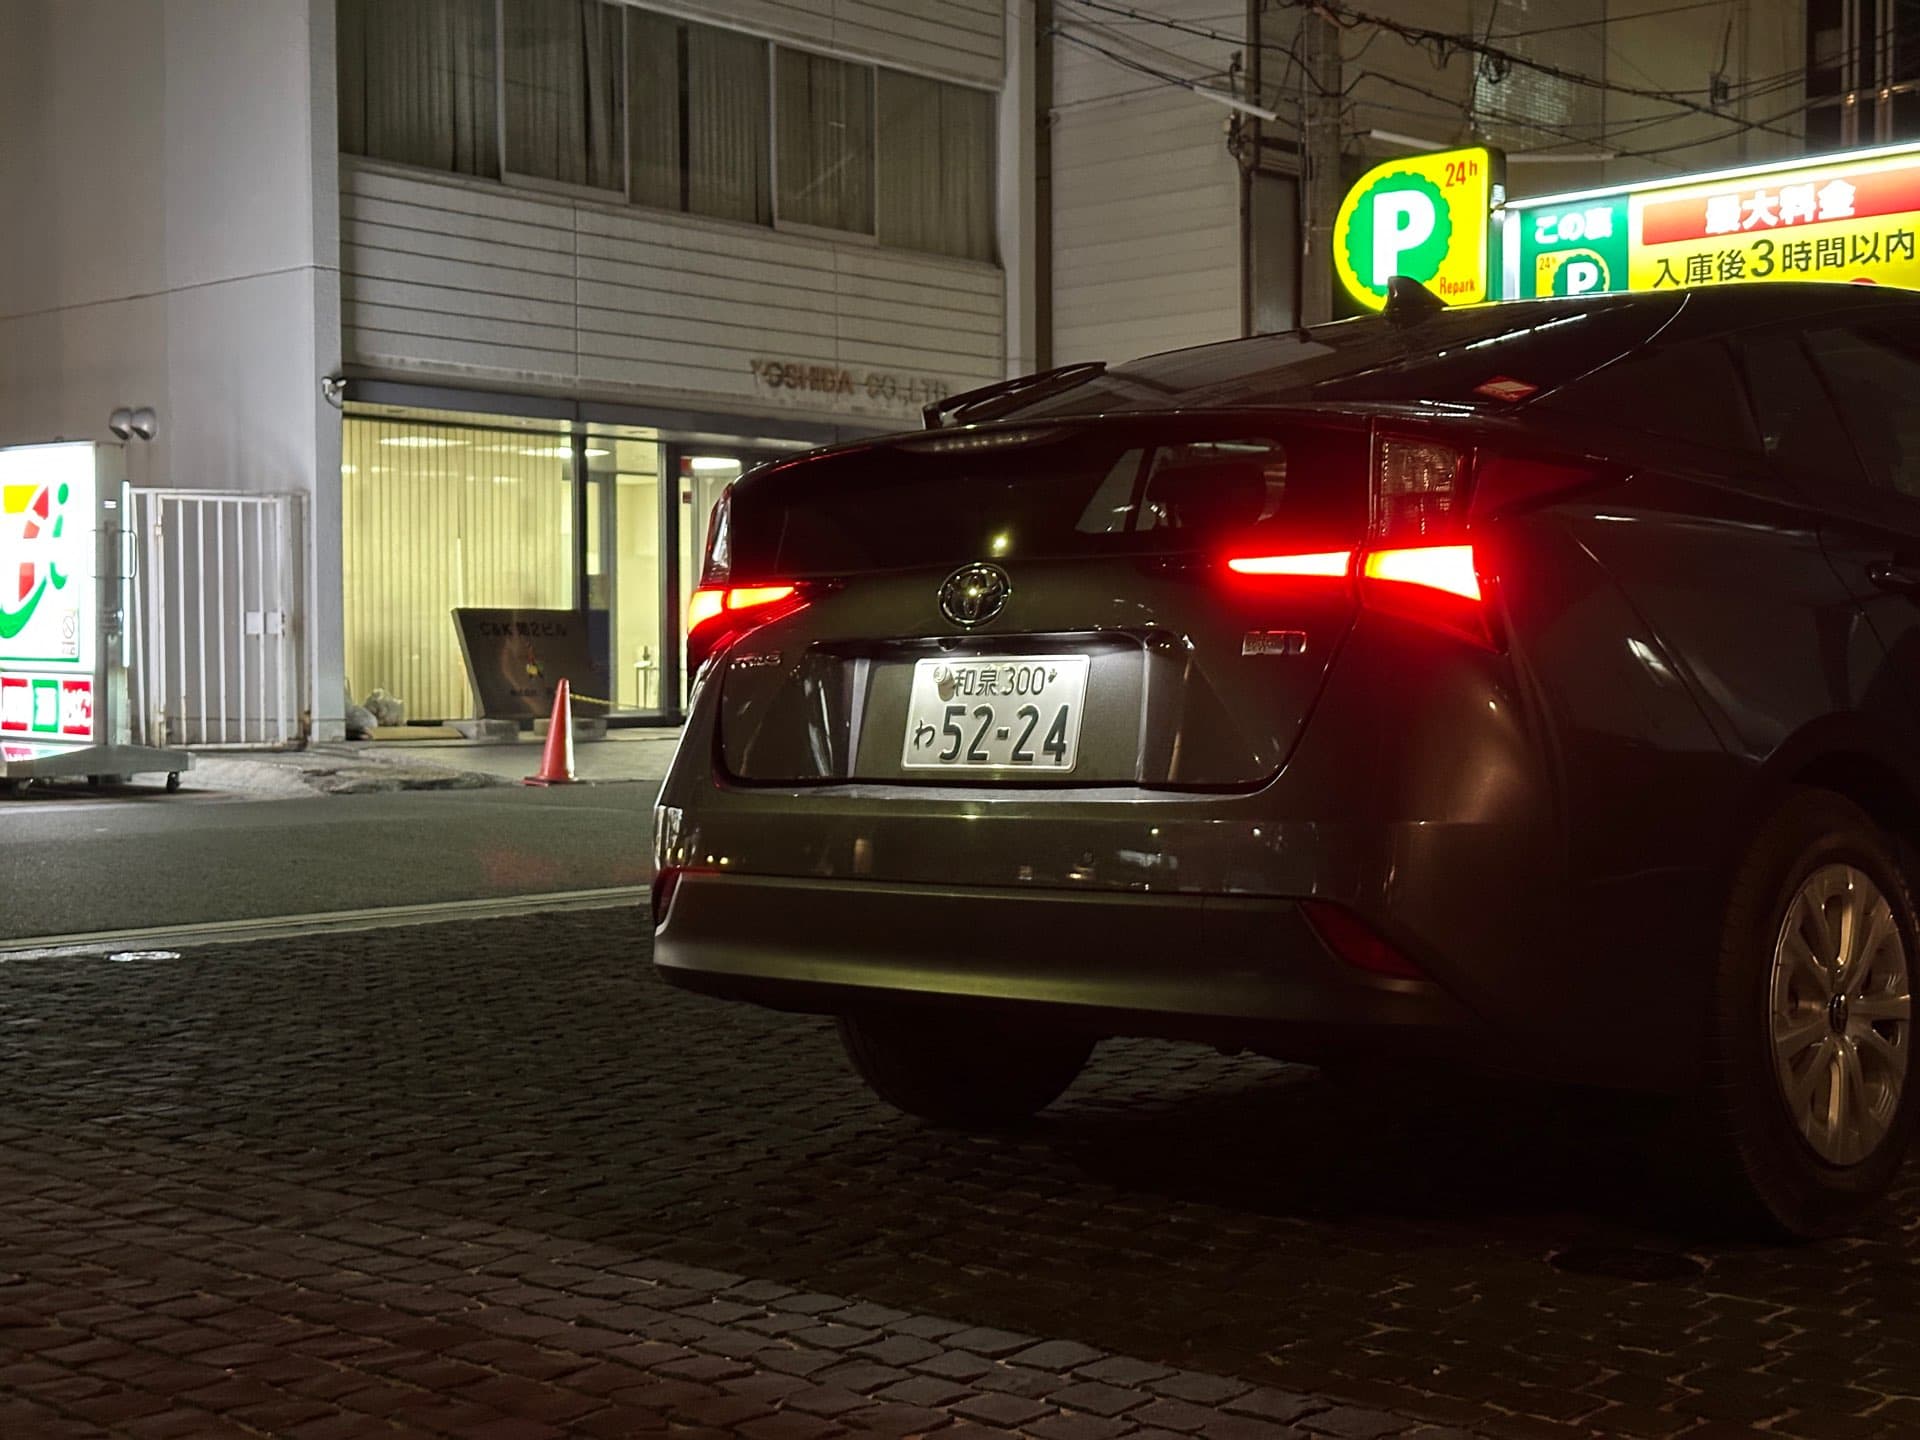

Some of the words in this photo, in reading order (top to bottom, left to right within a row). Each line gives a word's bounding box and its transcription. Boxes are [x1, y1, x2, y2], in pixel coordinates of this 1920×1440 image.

[1444, 160, 1478, 188] 24h
[1373, 189, 1436, 286] P
[1653, 228, 1915, 289] 入庫後3時間以内
[1439, 276, 1476, 296] Repark
[1567, 261, 1598, 295] P
[750, 359, 854, 394] YOSHIDA
[913, 720, 936, 750] わ
[939, 704, 1069, 762] 52-24
